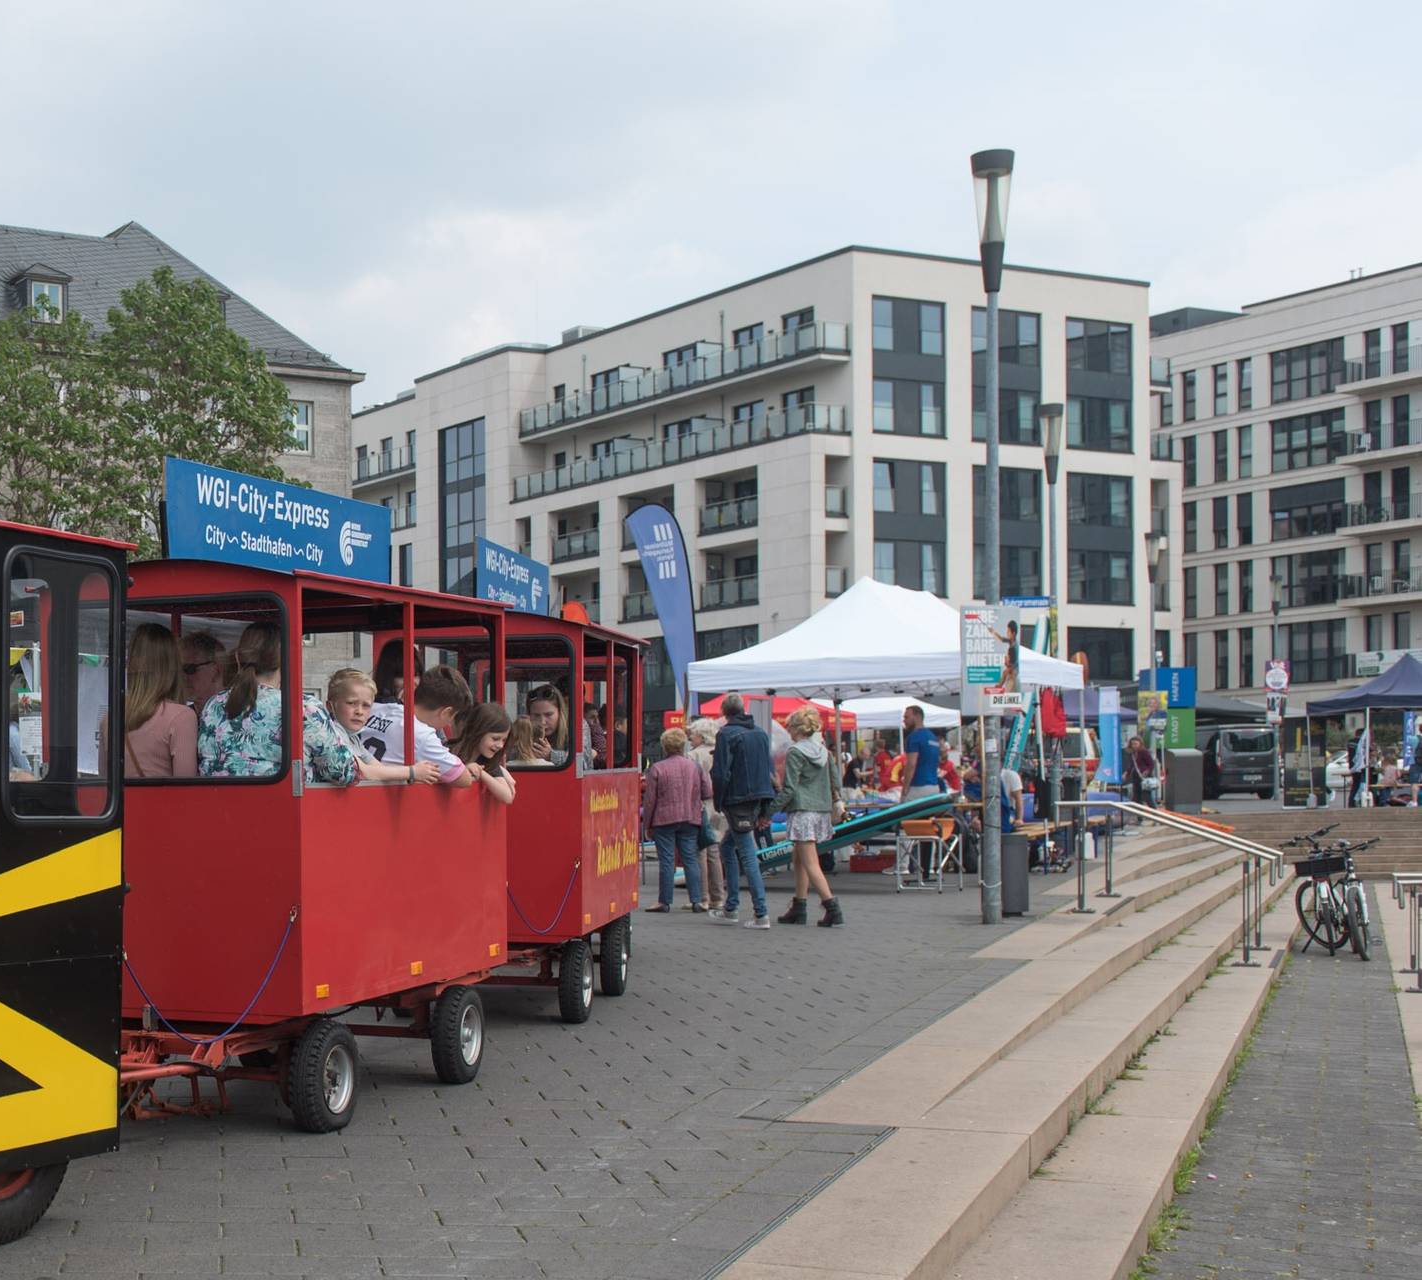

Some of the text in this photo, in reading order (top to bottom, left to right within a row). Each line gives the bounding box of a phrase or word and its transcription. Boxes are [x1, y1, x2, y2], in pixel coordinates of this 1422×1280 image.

[197, 473, 330, 529] WGI-City-Express
[205, 524, 324, 566] City Stadthafen City
[485, 547, 529, 585] WGI-City-Express
[966, 639, 995, 652] BARE
[1171, 672, 1180, 702] HAFEN
